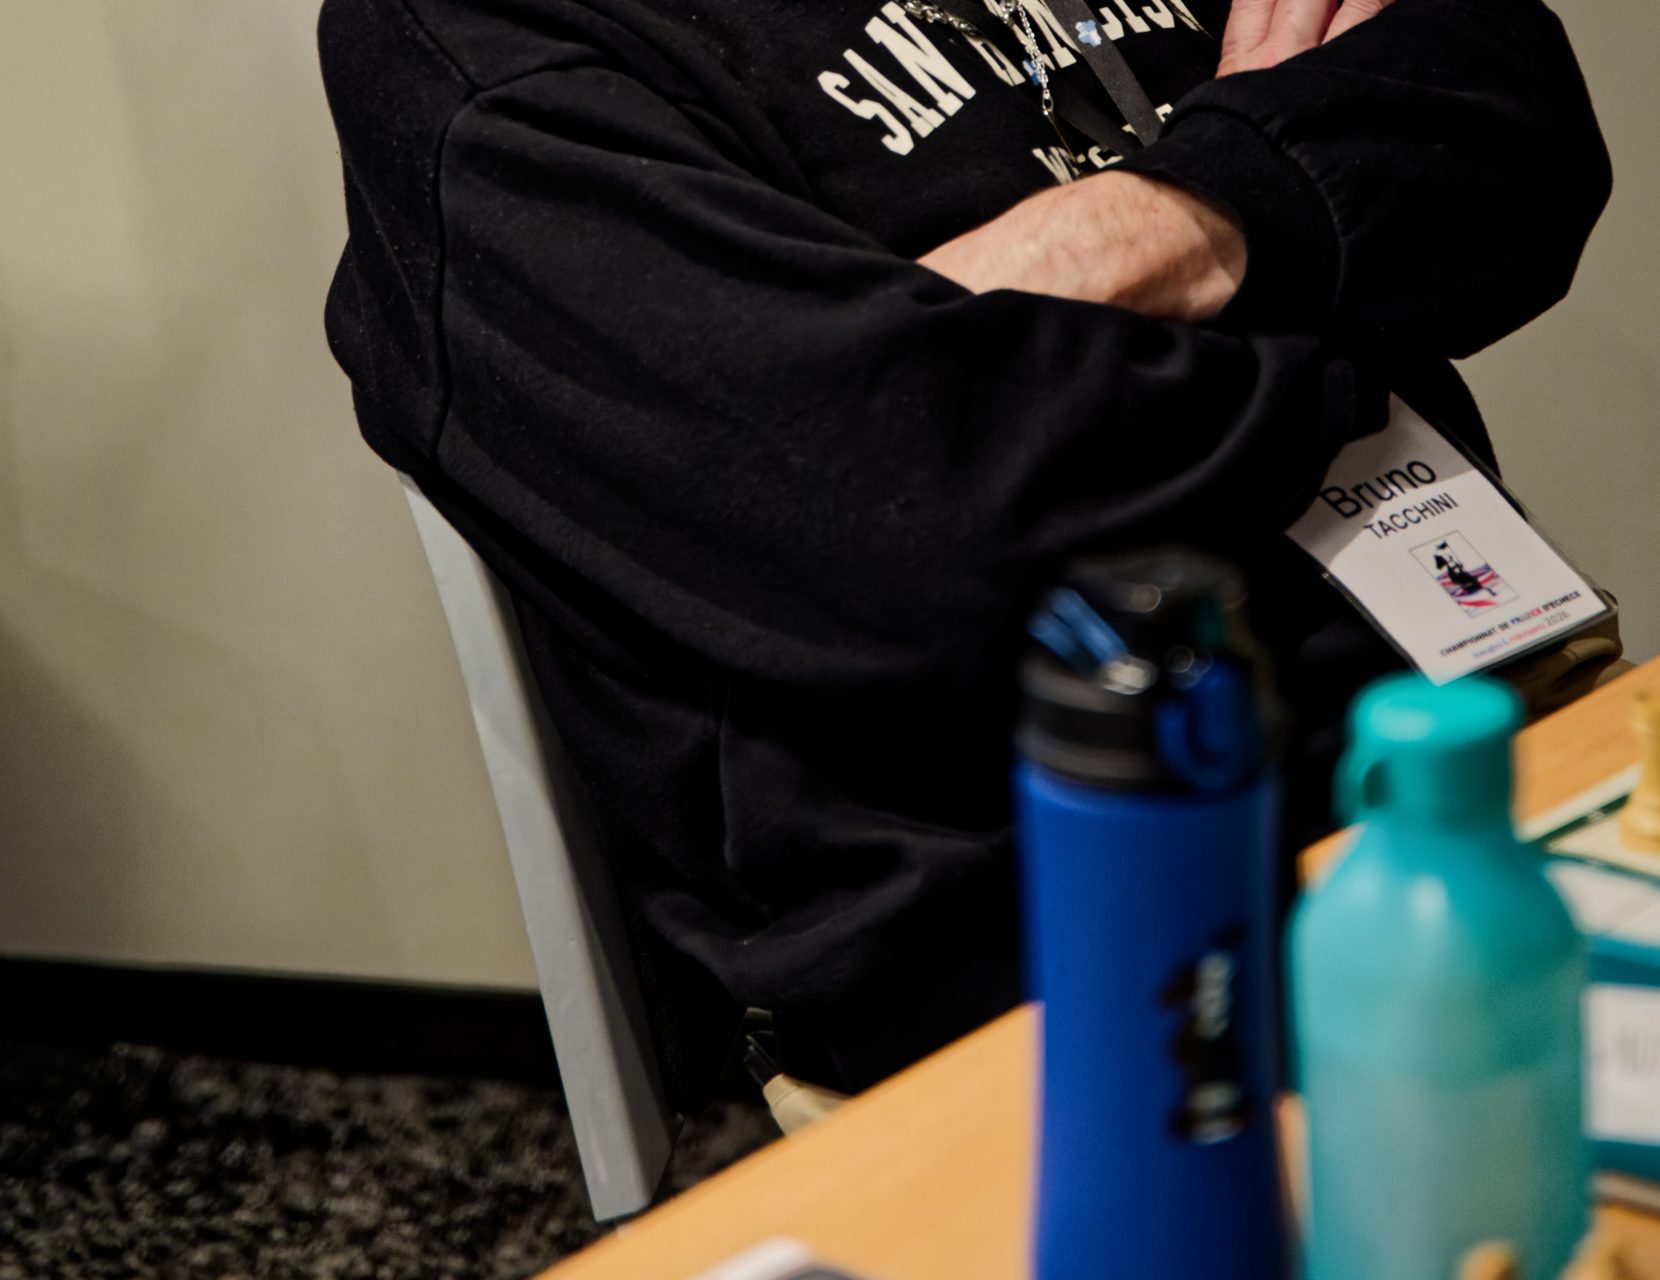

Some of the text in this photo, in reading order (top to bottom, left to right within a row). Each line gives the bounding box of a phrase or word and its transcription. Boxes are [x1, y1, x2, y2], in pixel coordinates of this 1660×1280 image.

[817, 1, 976, 156] SAN
[1318, 460, 1437, 519] Bruno
[1363, 492, 1459, 539] TACCHINI
[1440, 627, 1496, 657] CHAMPIONNAT
[1499, 621, 1511, 631] DE
